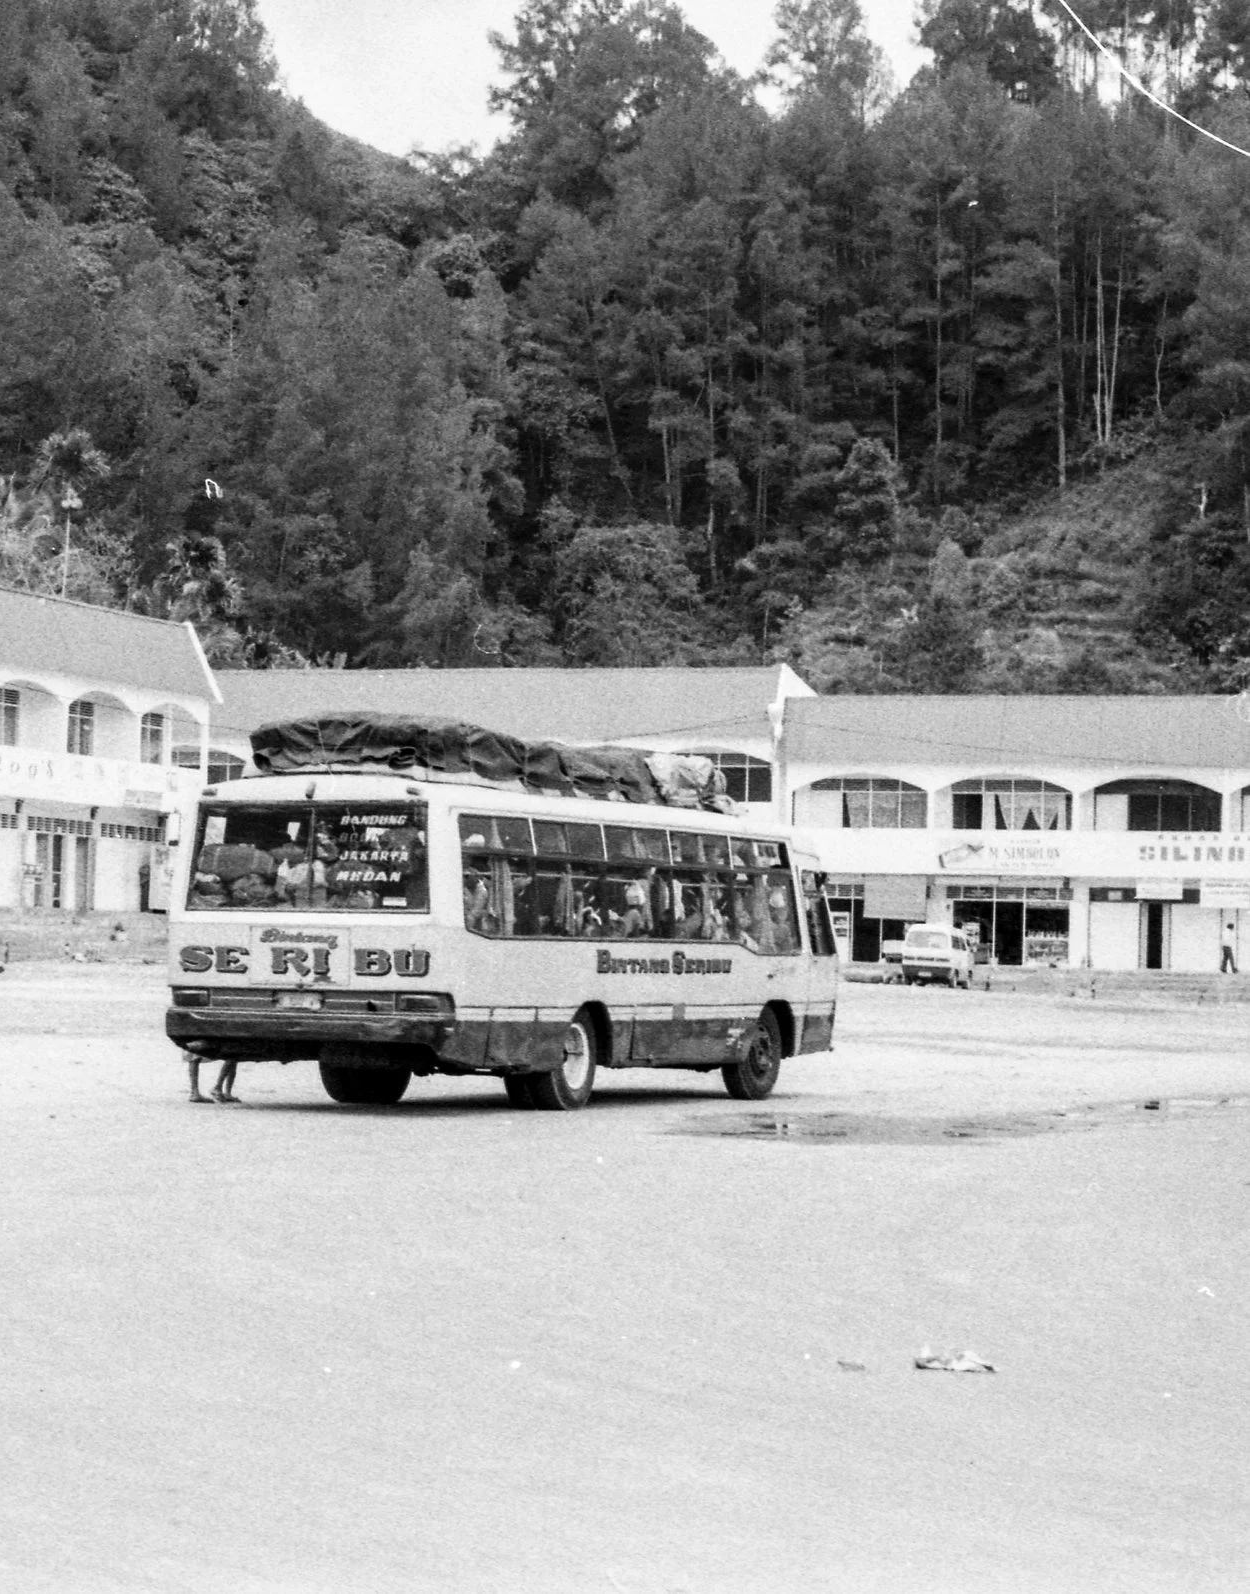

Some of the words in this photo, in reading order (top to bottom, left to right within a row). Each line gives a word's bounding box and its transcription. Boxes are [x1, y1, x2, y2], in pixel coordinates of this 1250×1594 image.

[340, 814, 408, 826] BANDUNG
[339, 850, 410, 862] JAKARTA
[336, 870, 402, 883] MEDAN
[259, 927, 339, 950] Bintang
